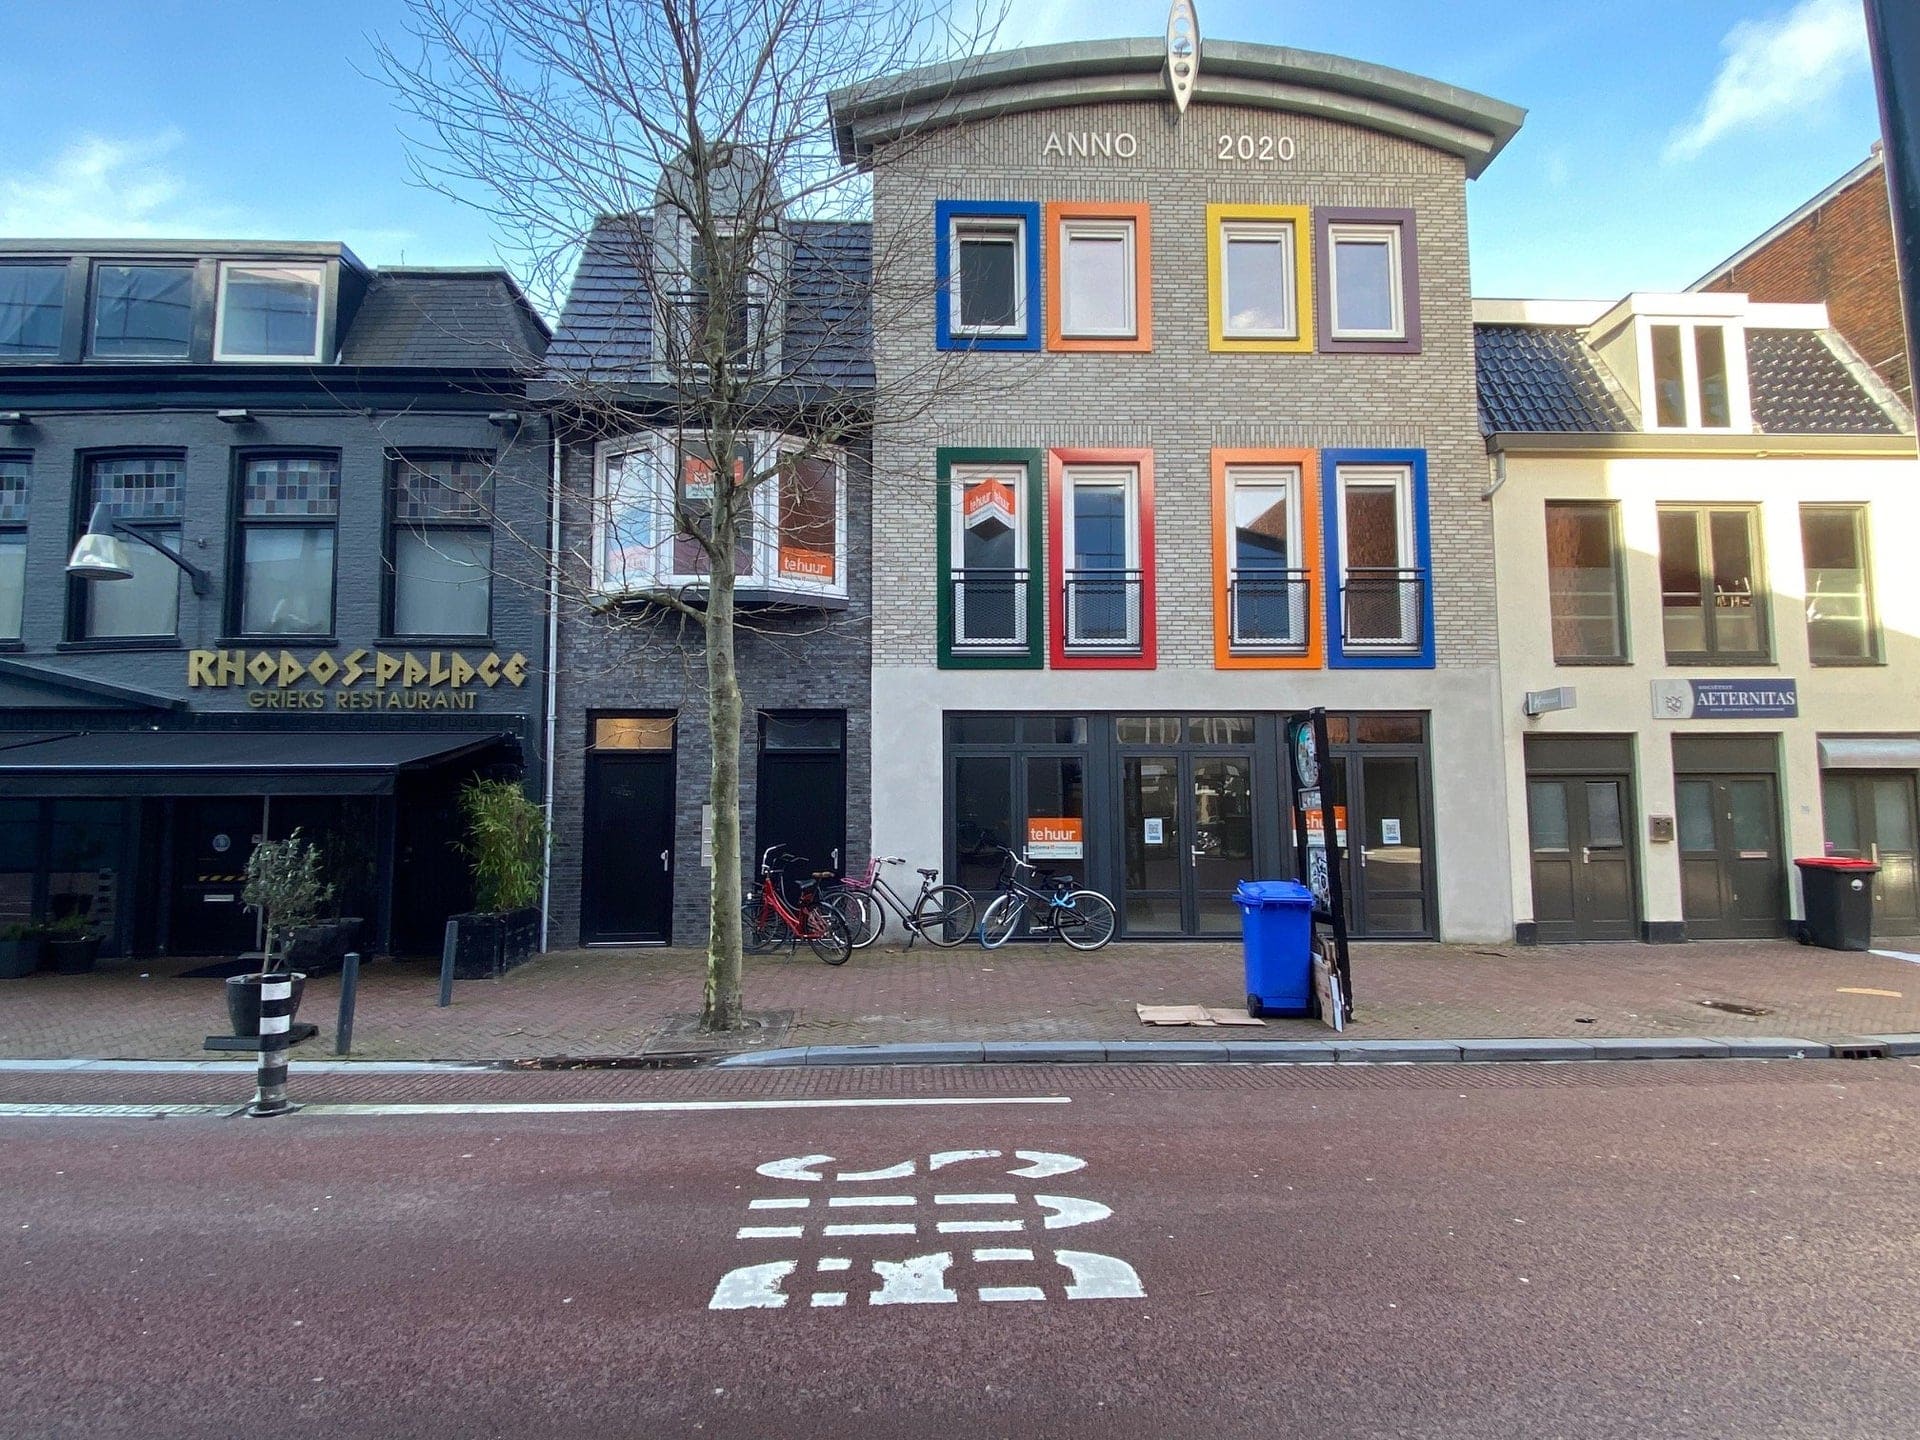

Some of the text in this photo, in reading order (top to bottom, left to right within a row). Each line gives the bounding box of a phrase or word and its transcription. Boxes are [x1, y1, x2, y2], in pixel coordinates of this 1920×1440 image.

[1042, 132, 1295, 161] ANNO 2020
[249, 690, 477, 709] GRIEKS RESTAURANT
[1696, 691, 1795, 706] AETERNITAS
[708, 1149, 1148, 1310] BUS
